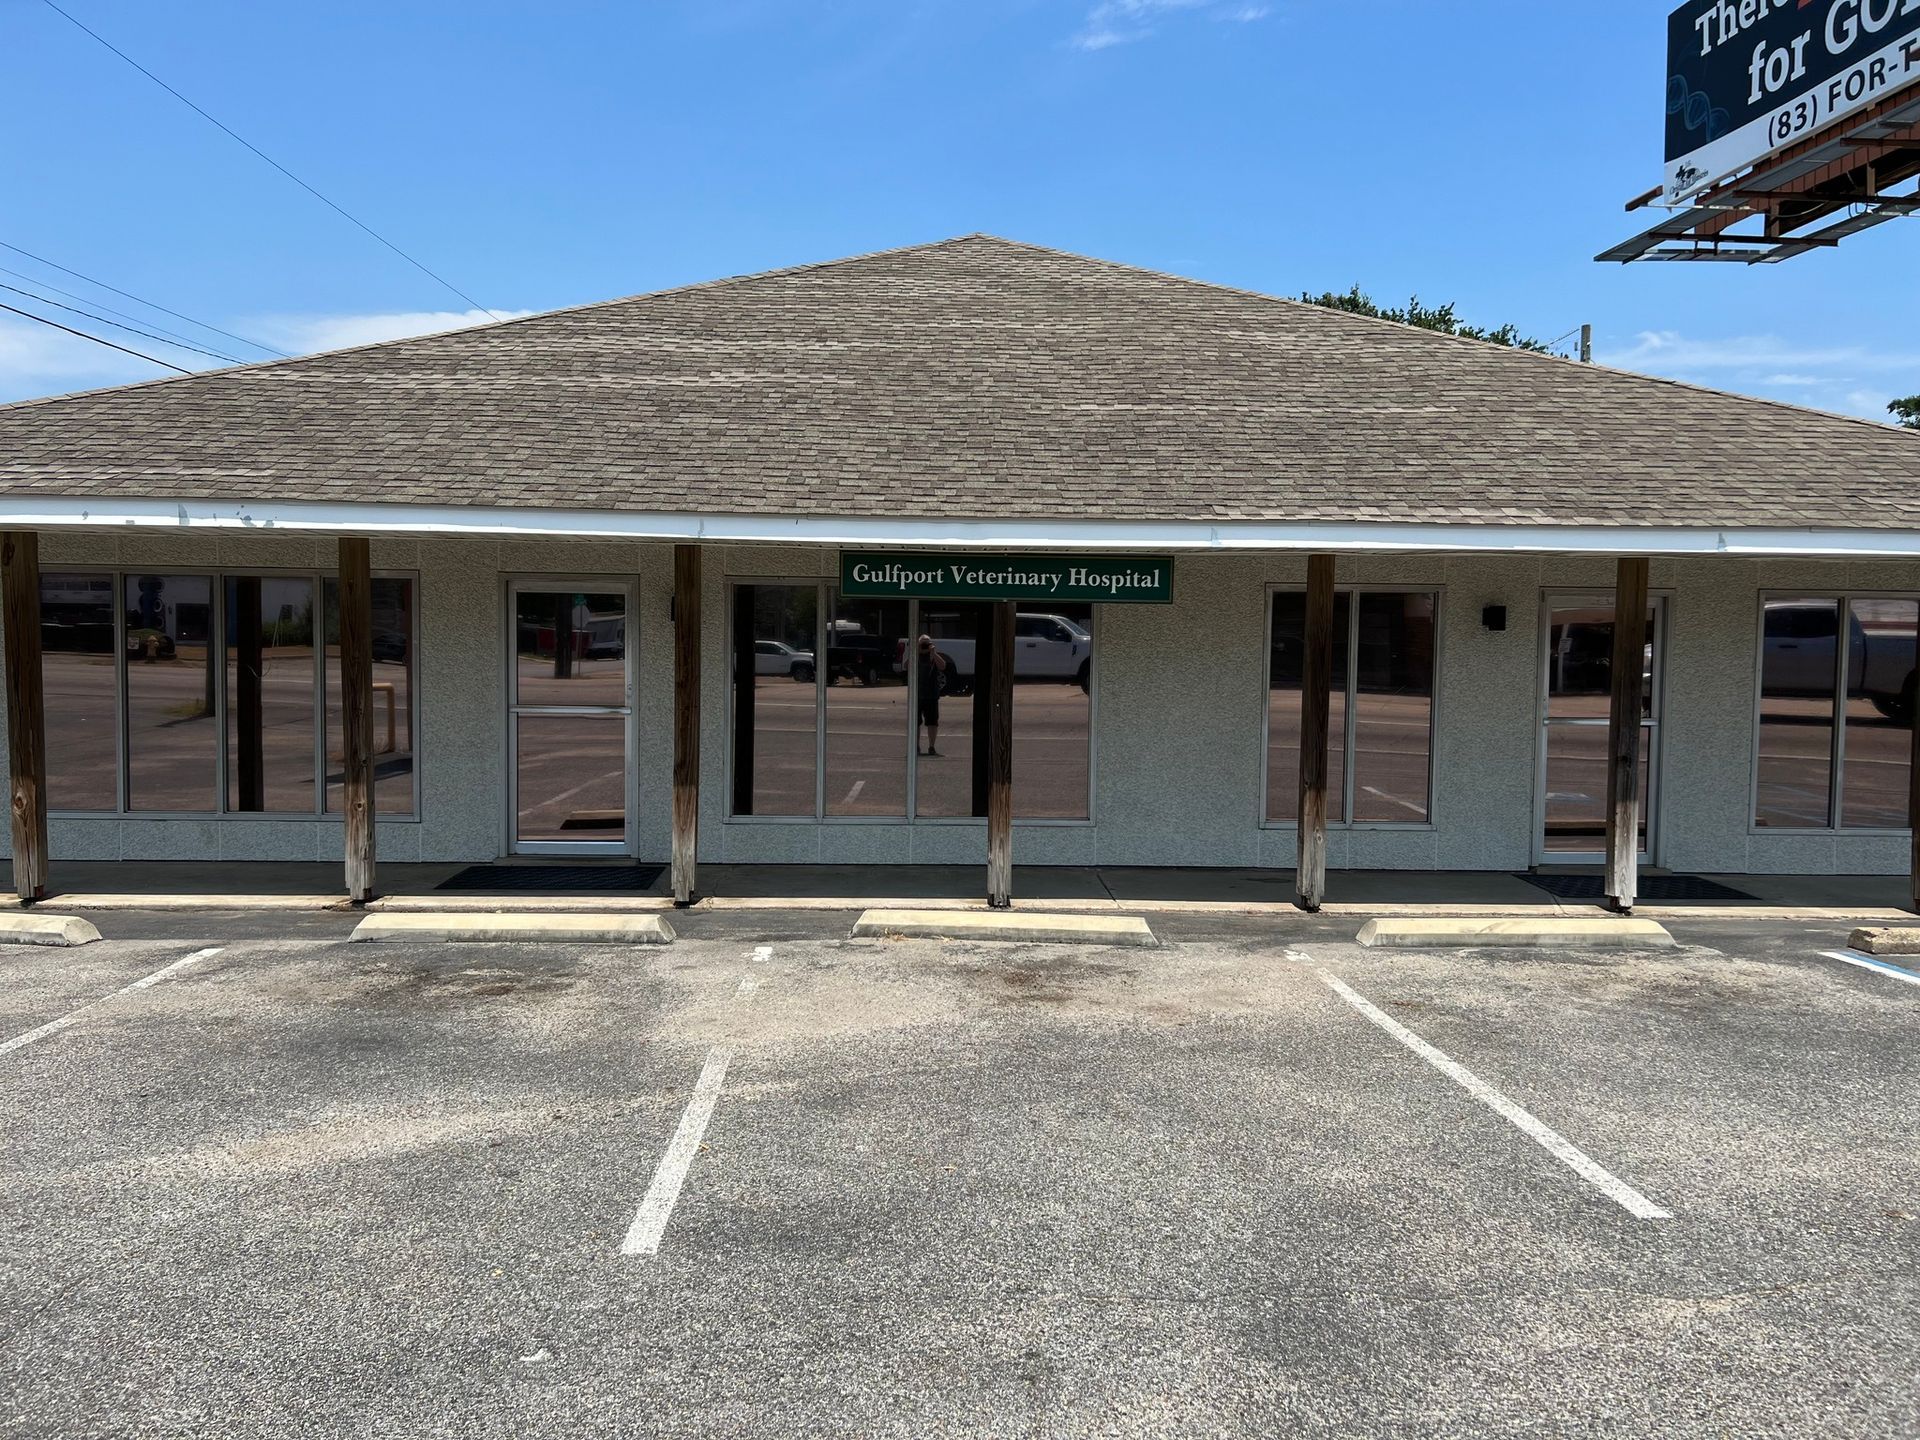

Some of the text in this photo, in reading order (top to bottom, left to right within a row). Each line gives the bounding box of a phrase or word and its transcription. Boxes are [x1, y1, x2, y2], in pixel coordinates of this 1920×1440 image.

[1694, 0, 1789, 57] The
[1748, 0, 1920, 105] for GO
[1768, 37, 1918, 148] (83) FOR-T
[852, 563, 1160, 594] Gulfport Veterinary Hospital
